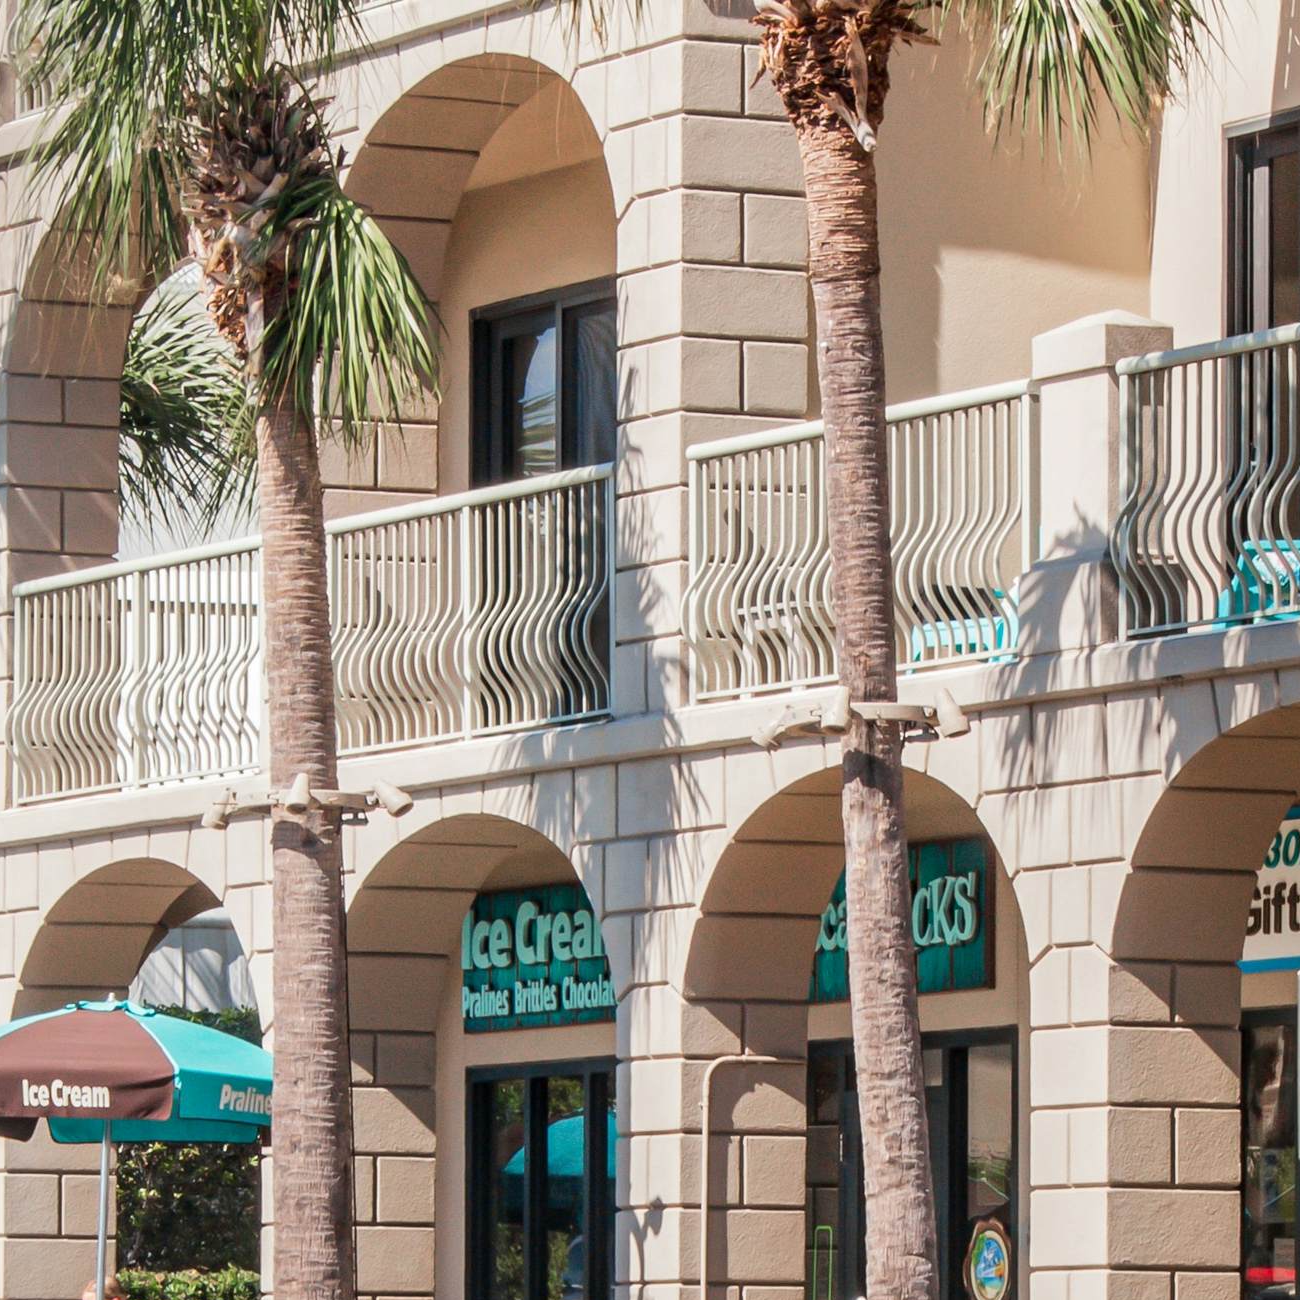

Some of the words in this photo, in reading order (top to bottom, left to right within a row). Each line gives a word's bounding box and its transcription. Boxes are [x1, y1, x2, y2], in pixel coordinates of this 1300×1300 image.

[461, 911, 511, 970] Ice
[462, 984, 509, 1018] Pralines
[515, 978, 557, 1014] Brittles
[22, 1079, 50, 1107] Ice
[51, 1079, 110, 1108] Cream
[219, 1084, 272, 1115] Praline
